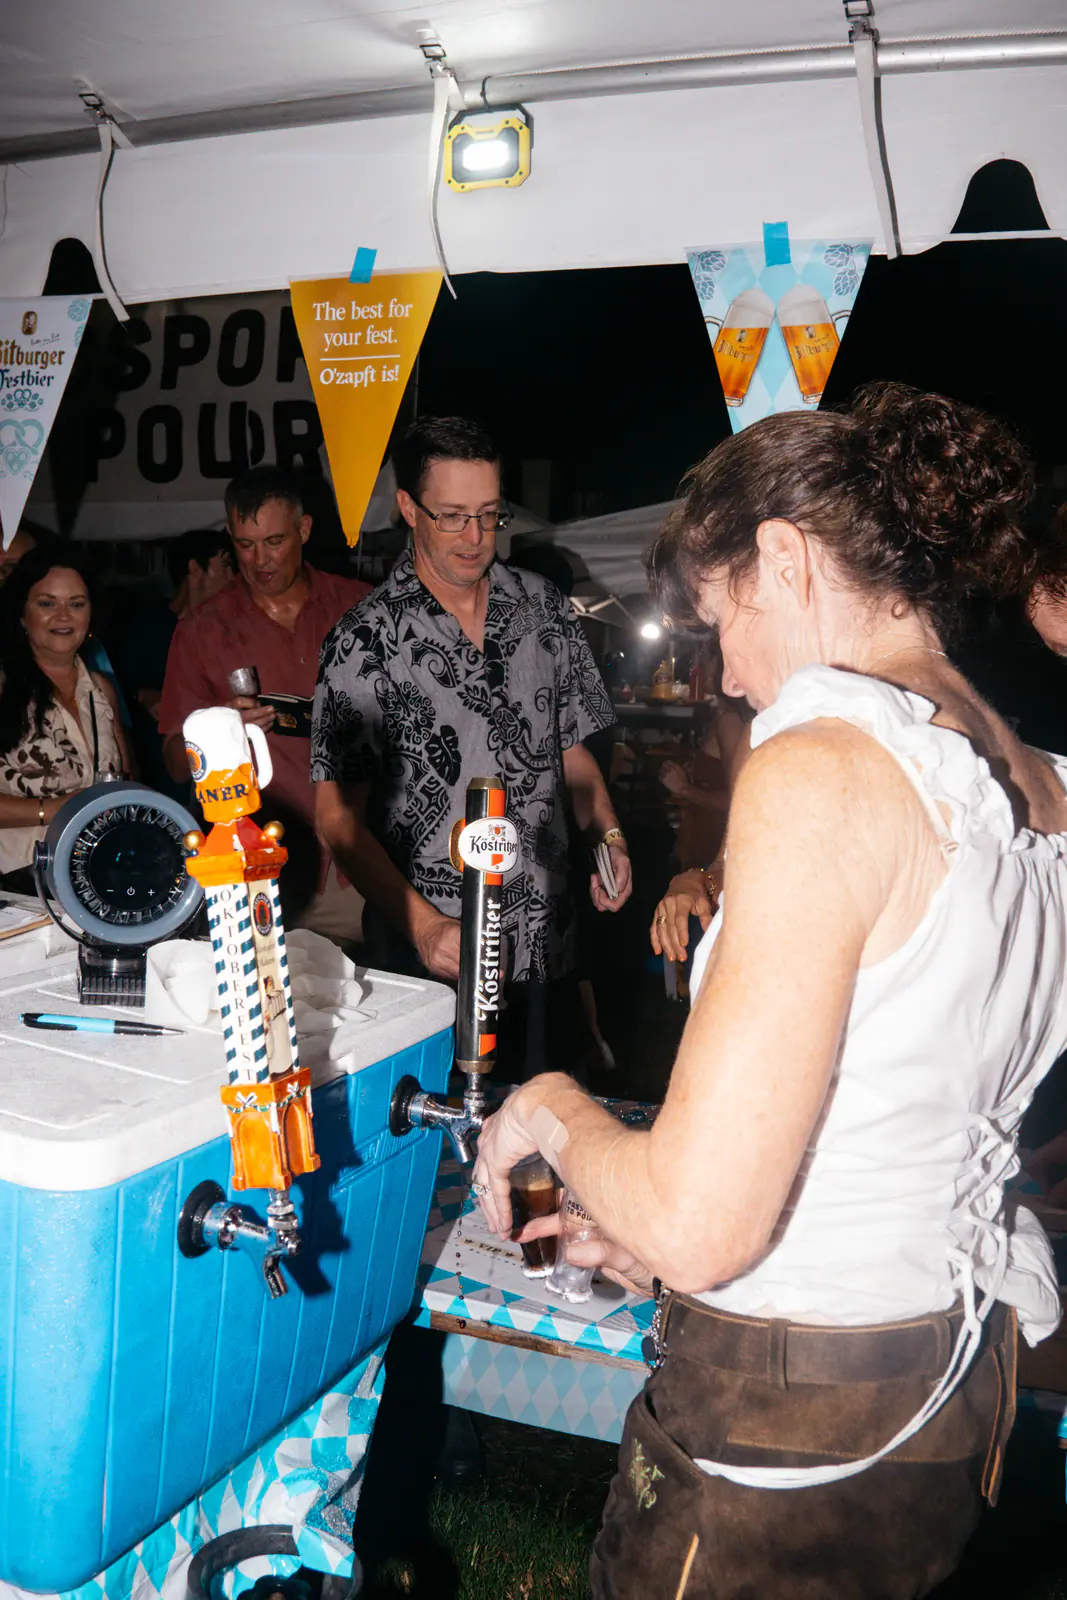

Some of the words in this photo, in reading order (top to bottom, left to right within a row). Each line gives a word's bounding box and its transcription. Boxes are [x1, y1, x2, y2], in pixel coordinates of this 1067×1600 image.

[312, 301, 346, 321] The
[351, 301, 384, 320] best
[388, 298, 413, 318] for
[324, 331, 362, 352] your
[365, 325, 398, 345] fest.
[0, 339, 66, 369] itburger
[320, 365, 376, 388] O'zapft
[381, 364, 400, 382] is!
[220, 889, 252, 1080] OKTOBERFEST
[567, 1199, 587, 1214] PASS
[576, 1211, 595, 1222] POU
